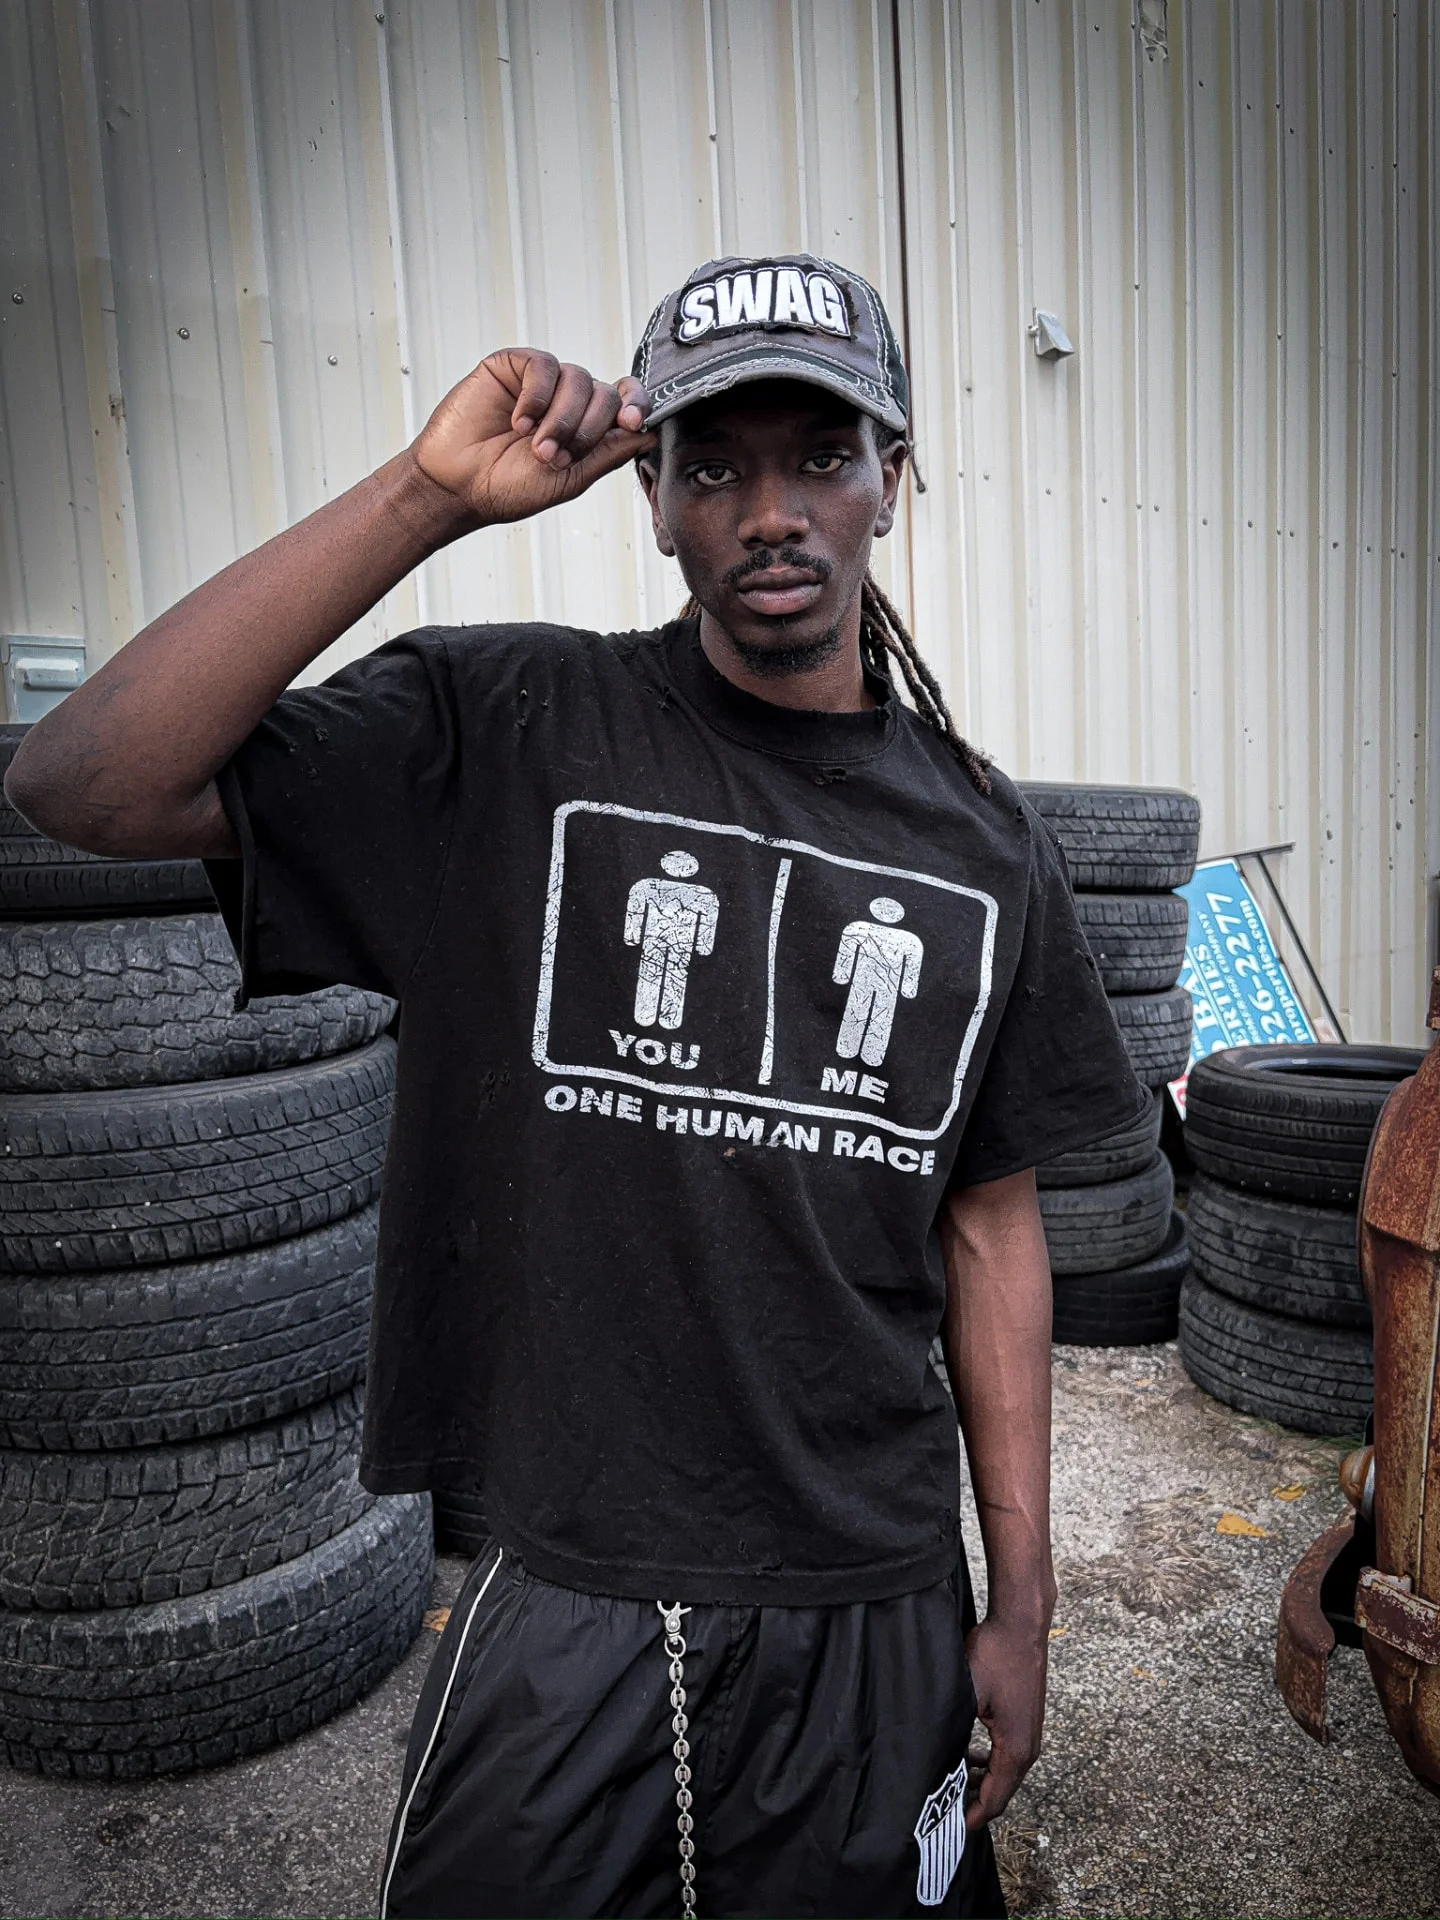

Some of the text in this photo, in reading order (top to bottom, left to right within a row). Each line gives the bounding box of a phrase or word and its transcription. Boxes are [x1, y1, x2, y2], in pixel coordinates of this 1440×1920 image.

[680, 266, 850, 341] SWAG
[608, 1029, 700, 1070] YOU
[820, 1067, 888, 1104] ME
[544, 1085, 935, 1175] ONE HUMAN RACE
